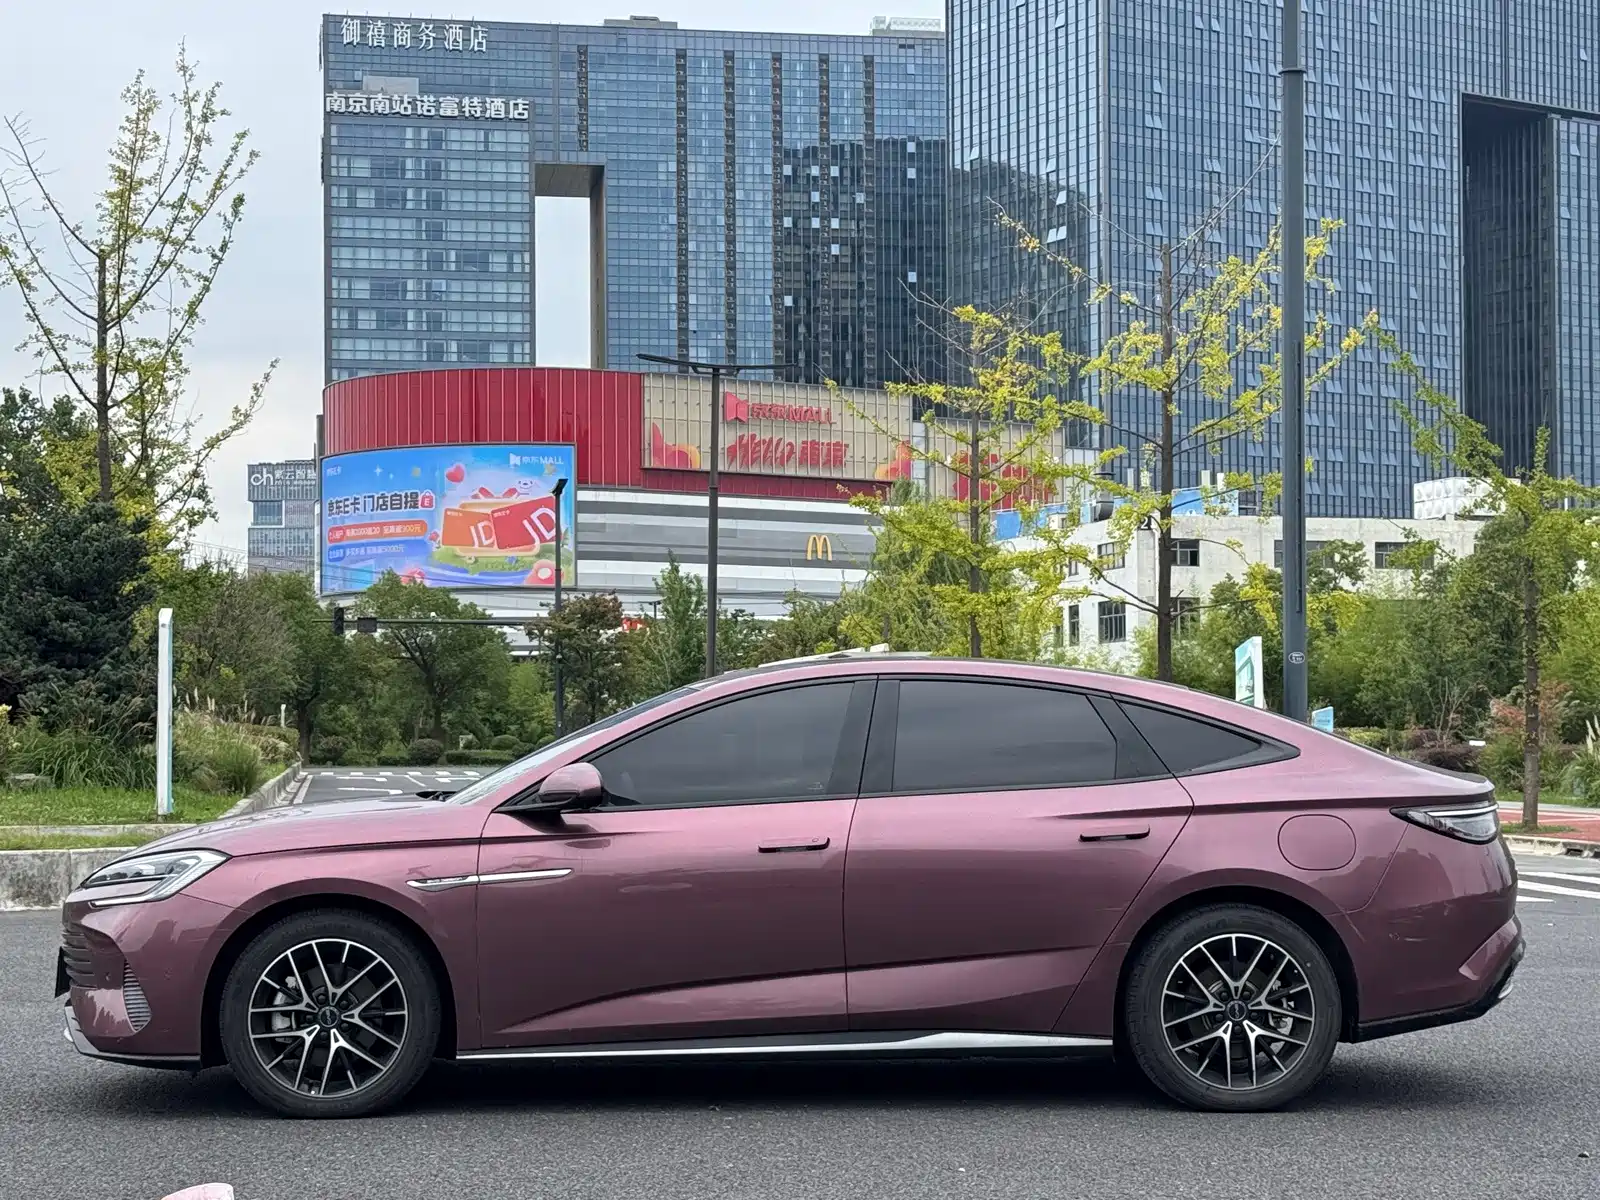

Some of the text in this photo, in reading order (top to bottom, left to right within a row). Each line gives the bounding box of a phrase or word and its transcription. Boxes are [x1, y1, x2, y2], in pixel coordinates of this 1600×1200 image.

[340, 18, 488, 52] 御禧商务酒店
[325, 91, 530, 120] 南京南站诺富特酒店
[363, 491, 420, 512] 门店自提
